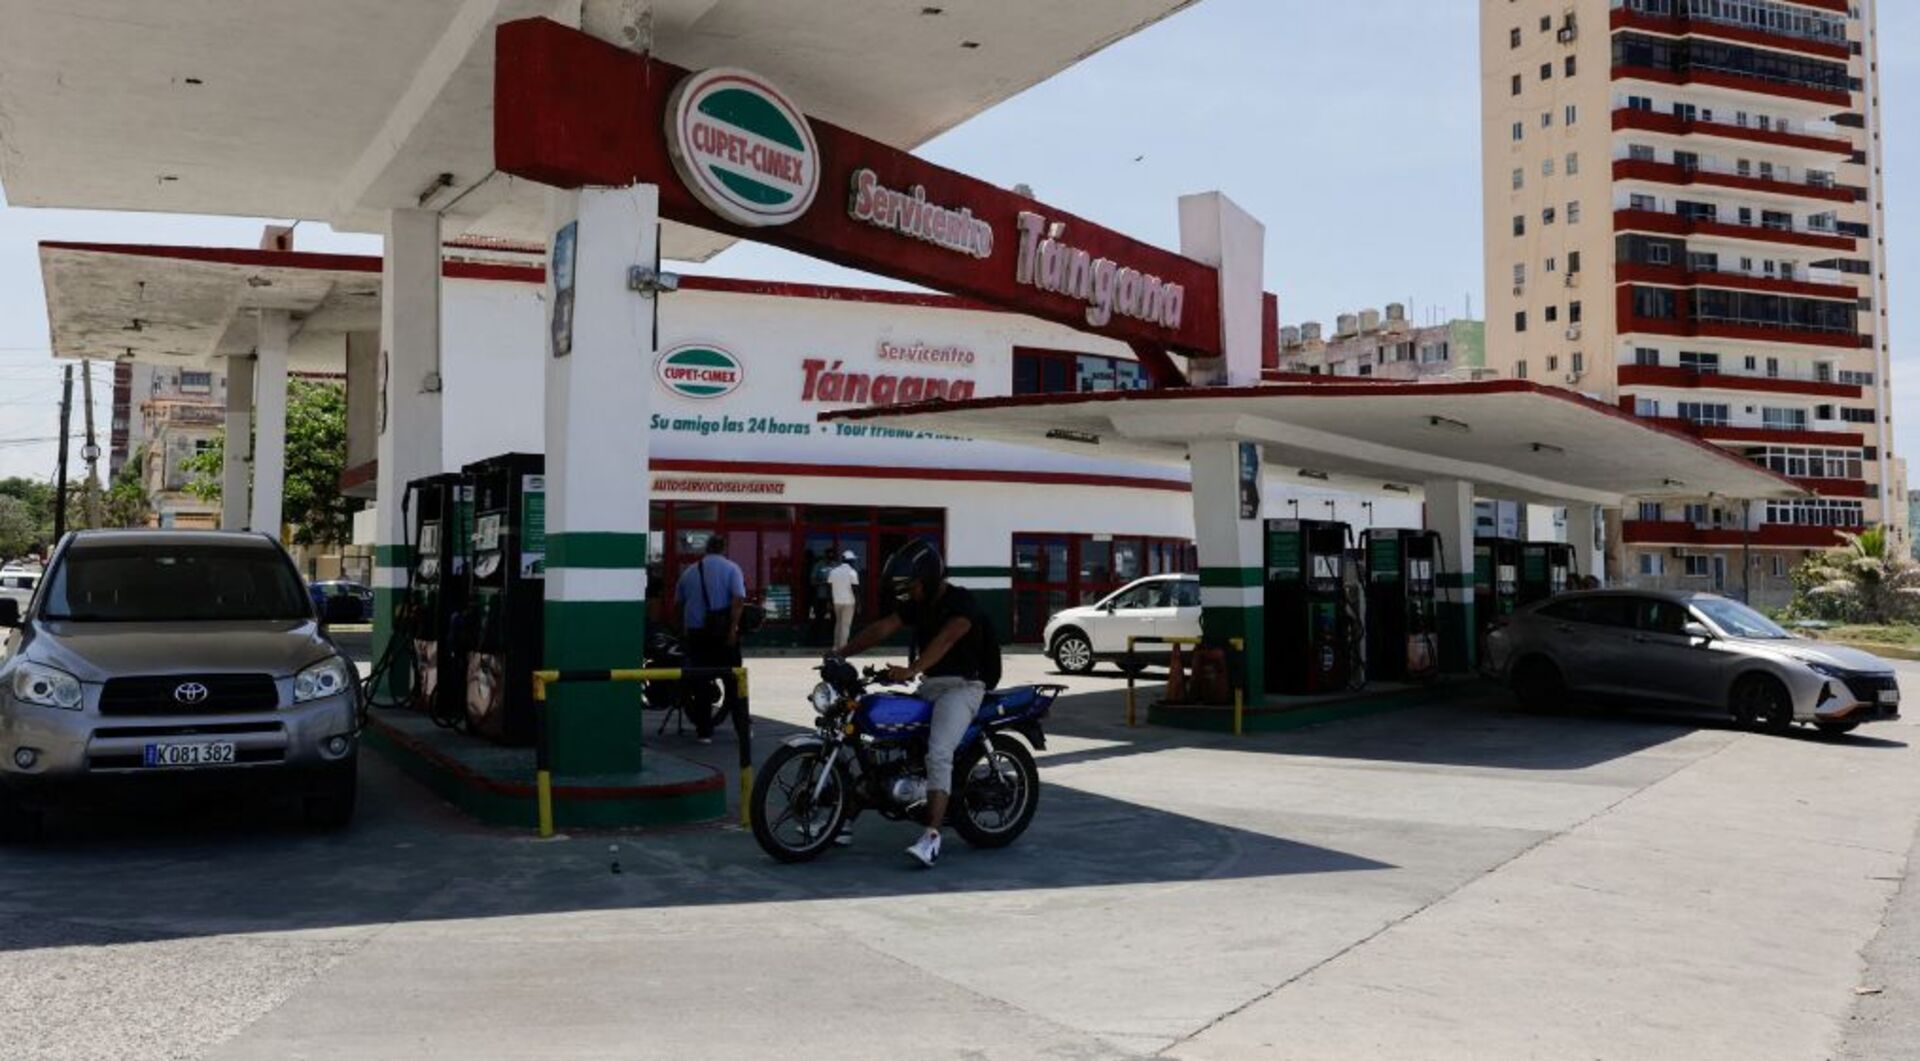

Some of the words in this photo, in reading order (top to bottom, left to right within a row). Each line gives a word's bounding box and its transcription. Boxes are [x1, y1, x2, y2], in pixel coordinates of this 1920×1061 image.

[692, 122, 803, 186] CUPET-CIMEX
[849, 168, 994, 259] Servicentro
[1016, 211, 1185, 326] Tángana
[879, 342, 975, 364] Servicentro
[664, 367, 736, 383] CUPET-CIMEX
[650, 414, 669, 430] Su
[672, 415, 720, 435] amigo
[722, 416, 744, 432] las
[748, 418, 766, 433] 24
[768, 417, 811, 435] horas
